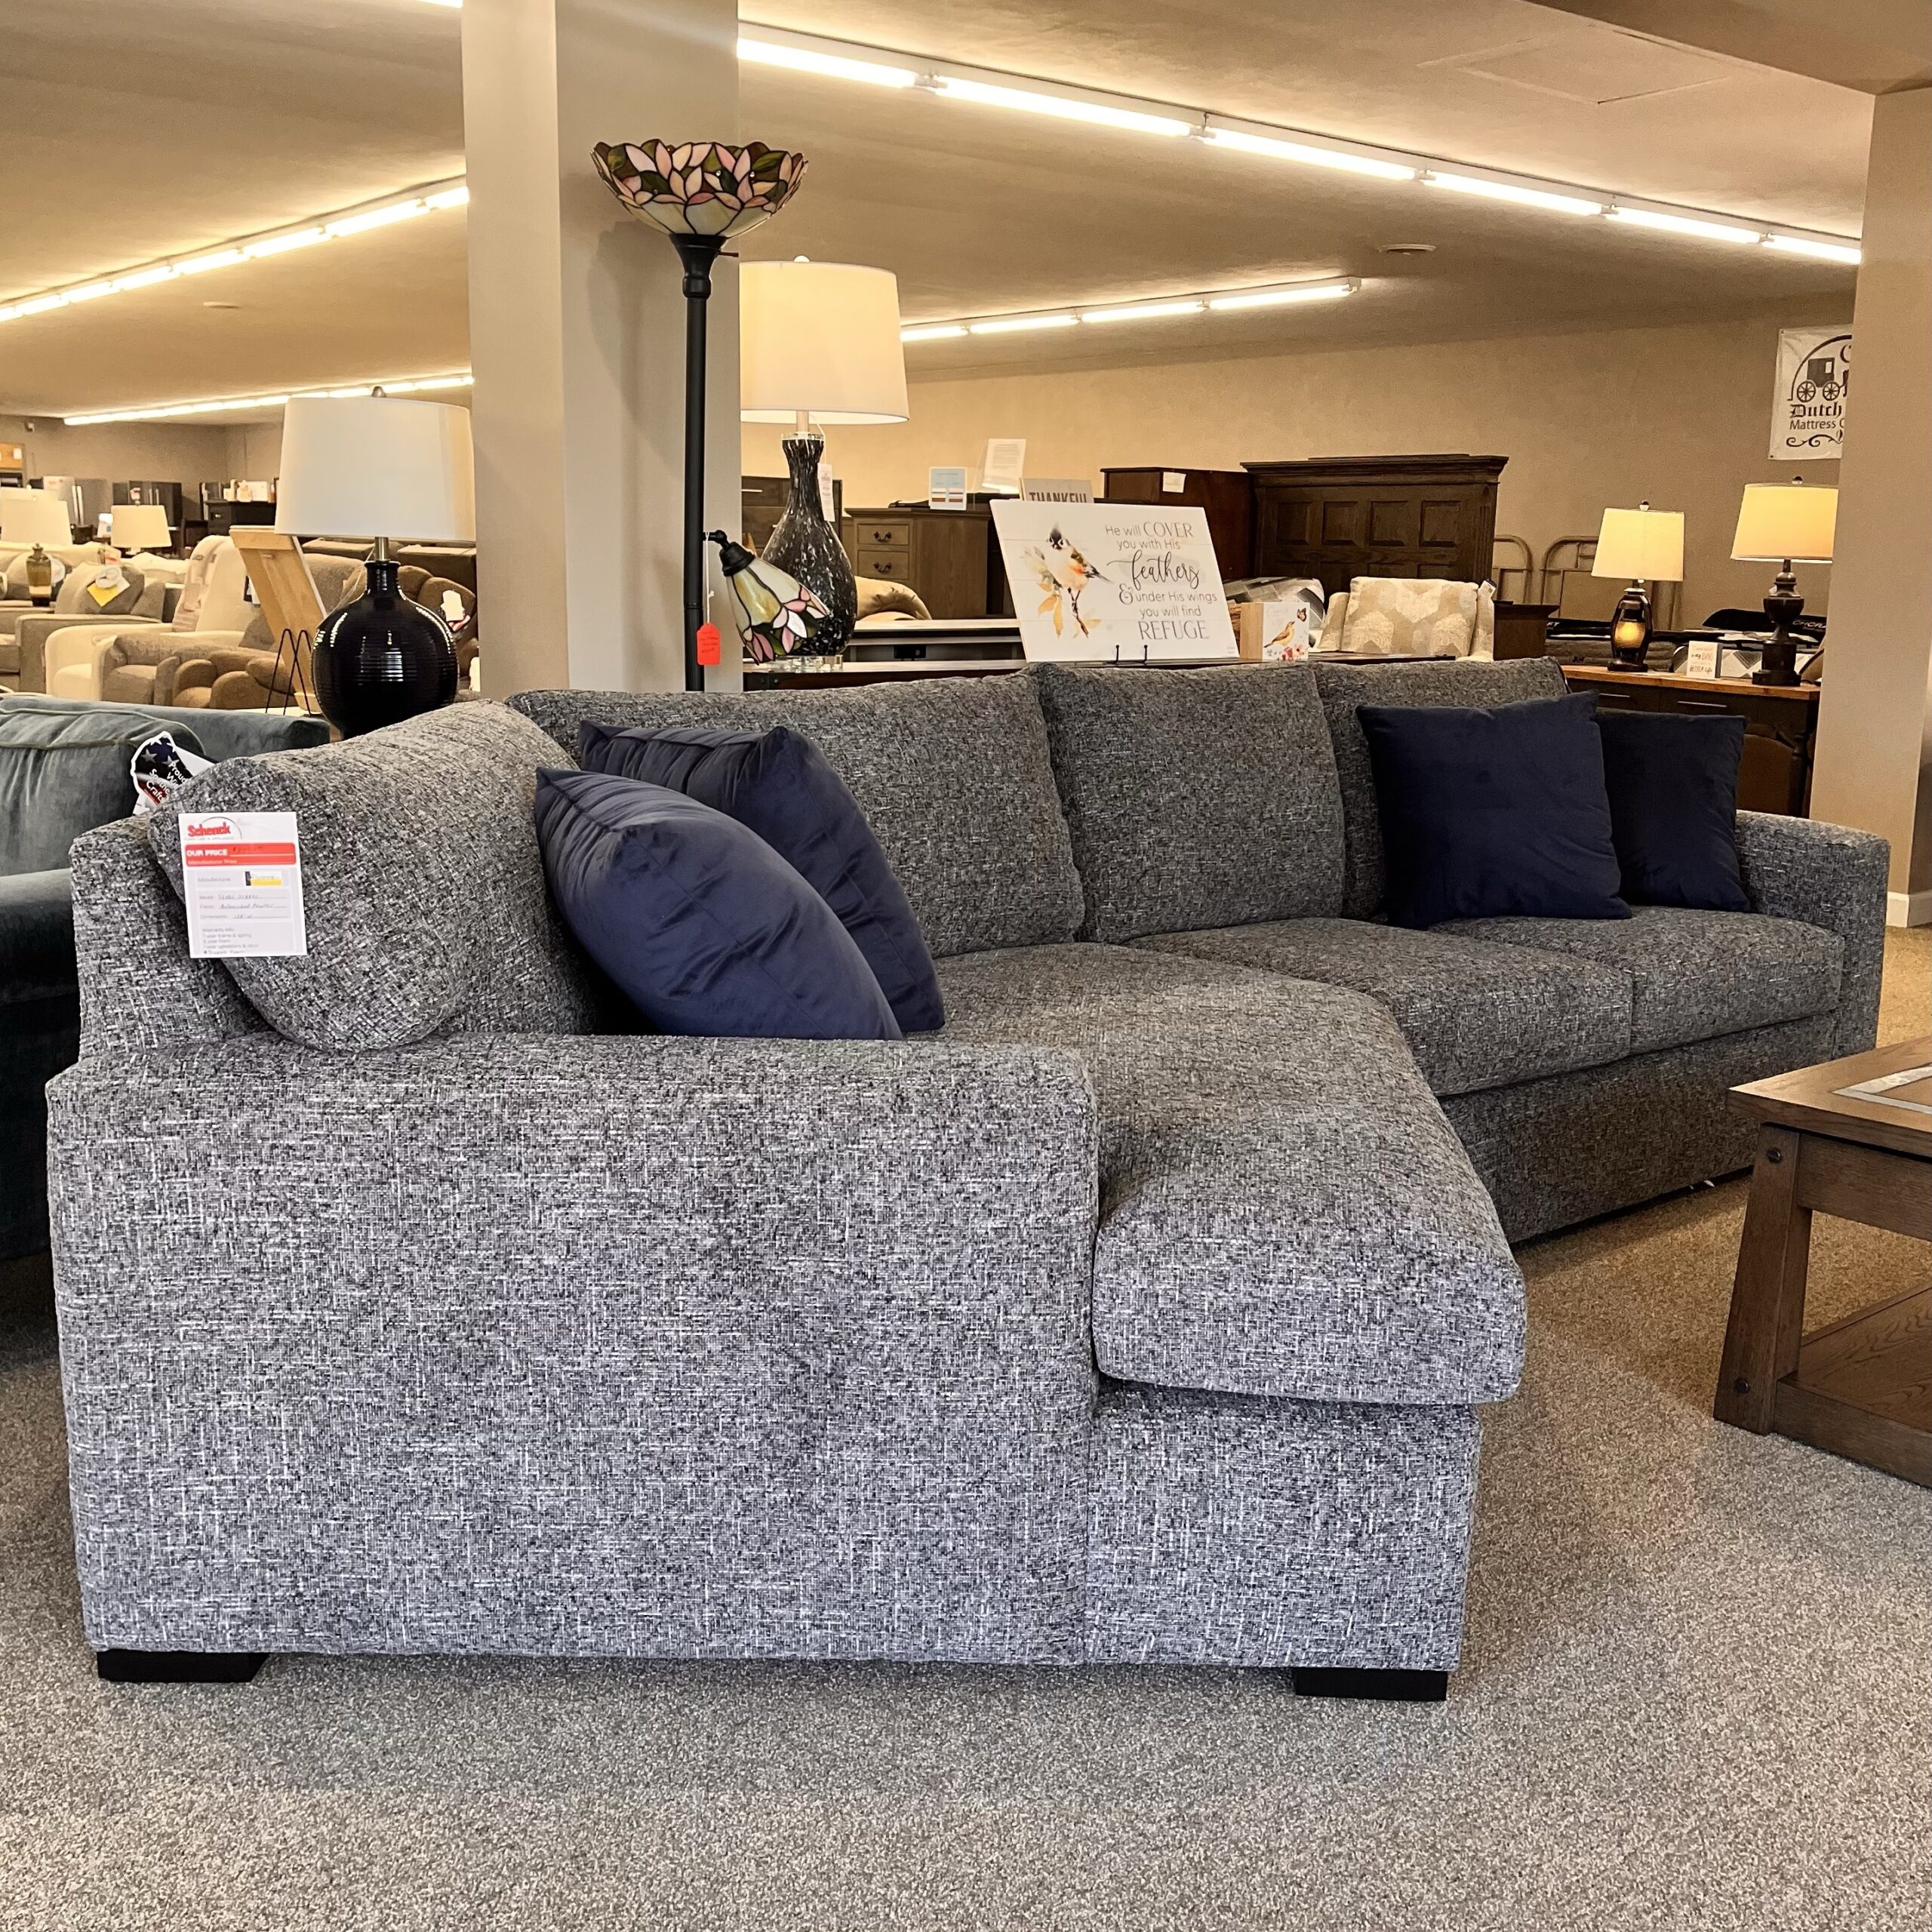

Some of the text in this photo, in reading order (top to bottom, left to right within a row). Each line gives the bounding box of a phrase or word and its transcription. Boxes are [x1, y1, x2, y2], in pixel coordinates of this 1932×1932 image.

[1789, 401, 1841, 418] Dutch
[1789, 420, 1836, 429] Mattress
[1106, 521, 1194, 537] He will COVER
[1117, 540, 1181, 551] you with His
[1106, 549, 1200, 591] feathers
[1118, 583, 1217, 605] & under His wings
[1140, 605, 1201, 619] you will find
[1138, 620, 1210, 640] REFUGE
[188, 821, 231, 837] Schenck
[205, 848, 228, 857] PRICE
